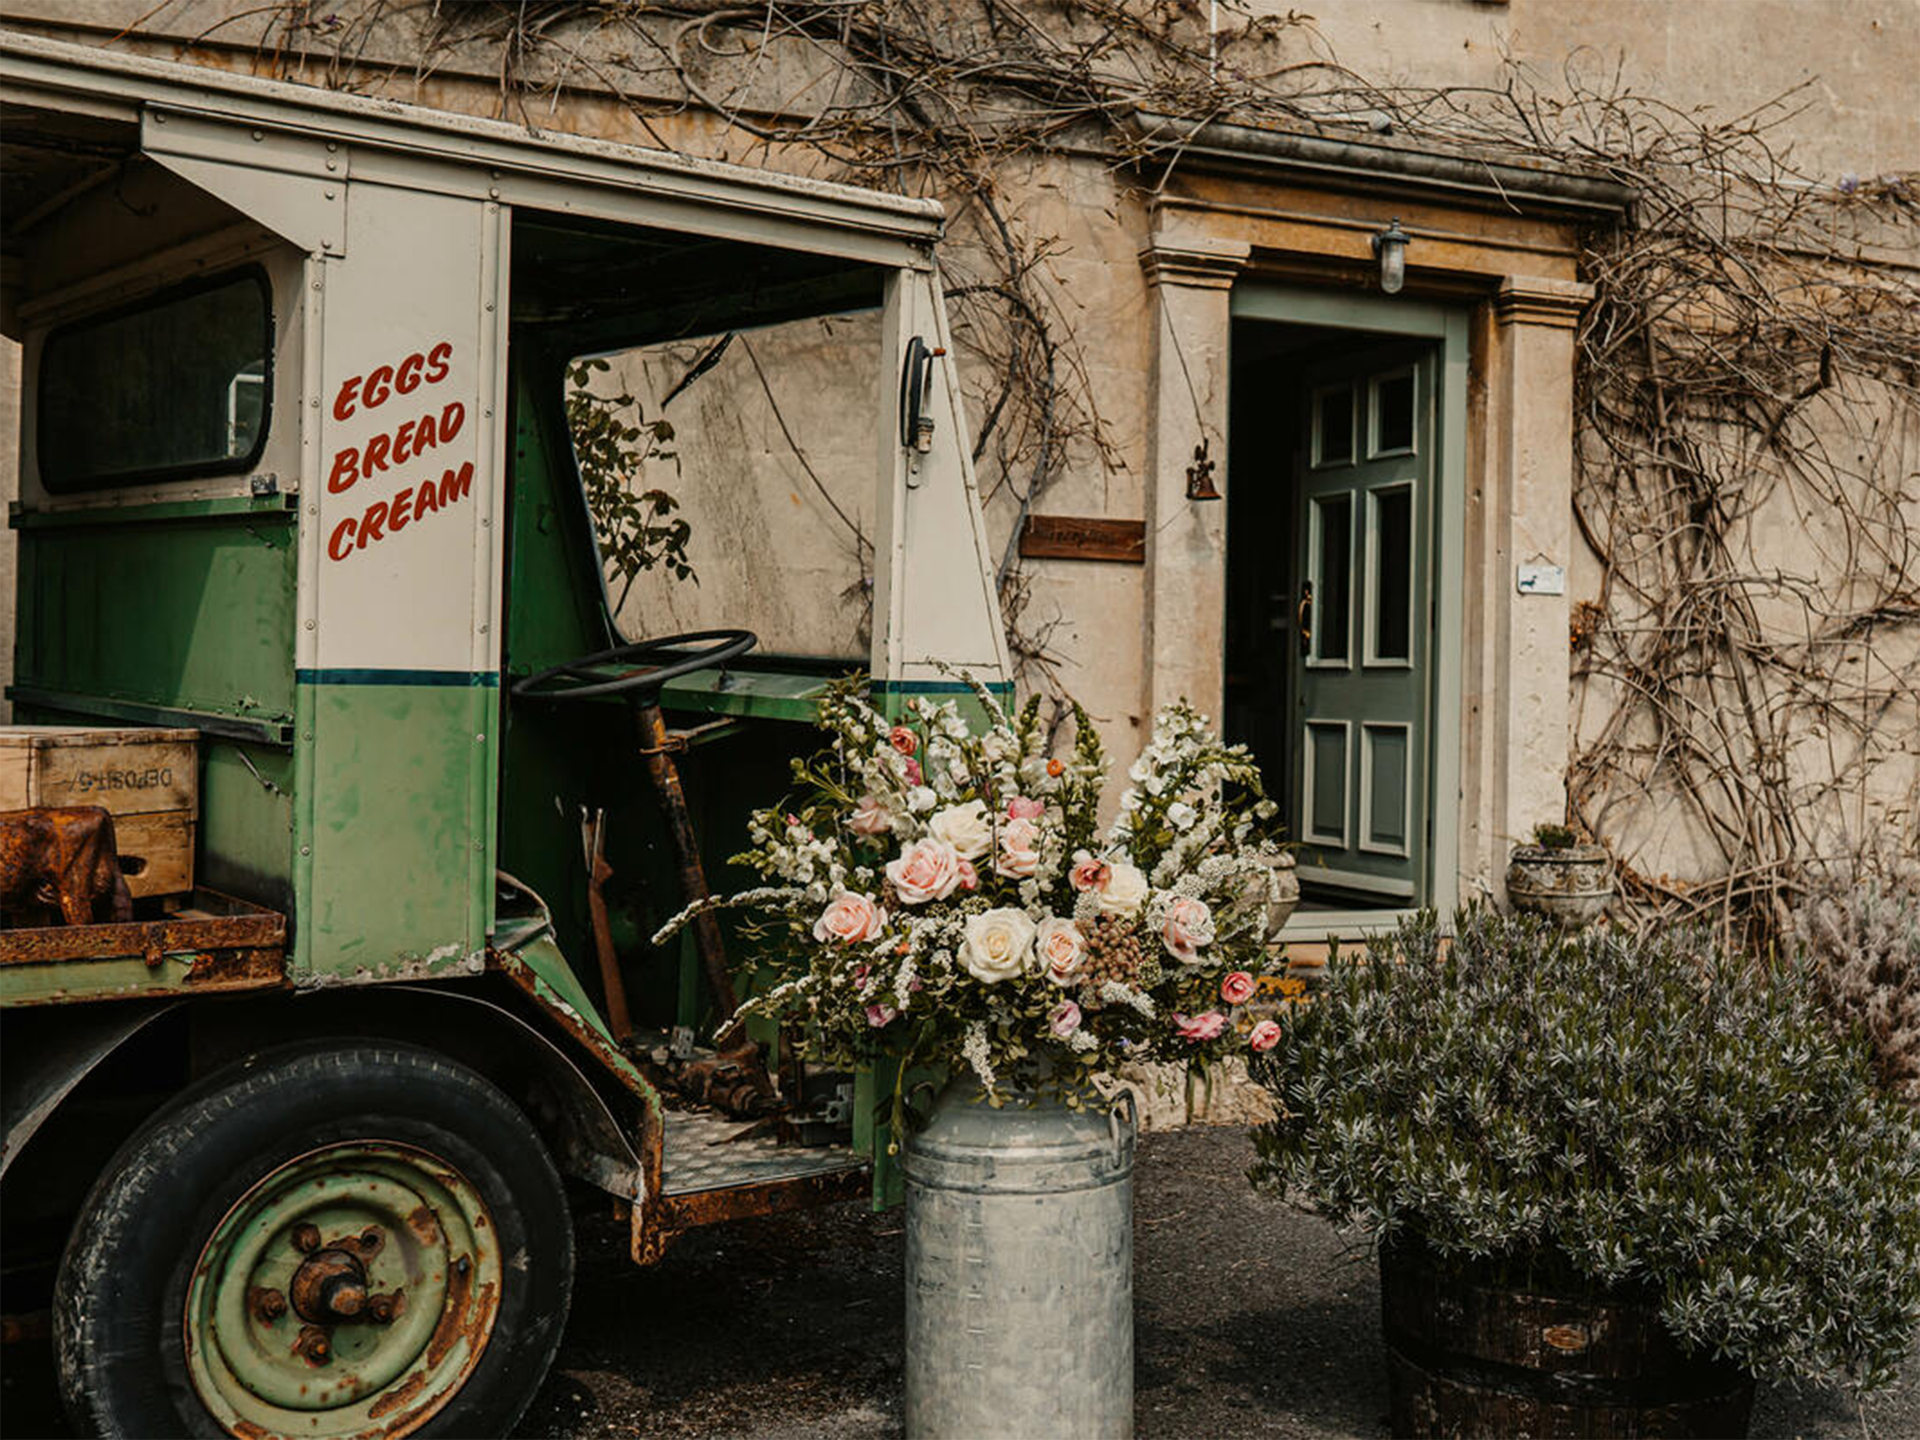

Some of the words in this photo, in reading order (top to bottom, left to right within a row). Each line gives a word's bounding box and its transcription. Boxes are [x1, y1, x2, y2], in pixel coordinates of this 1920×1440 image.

[333, 342, 452, 421] EGGS
[328, 402, 465, 494] BREAD
[328, 461, 474, 561] CREAM
